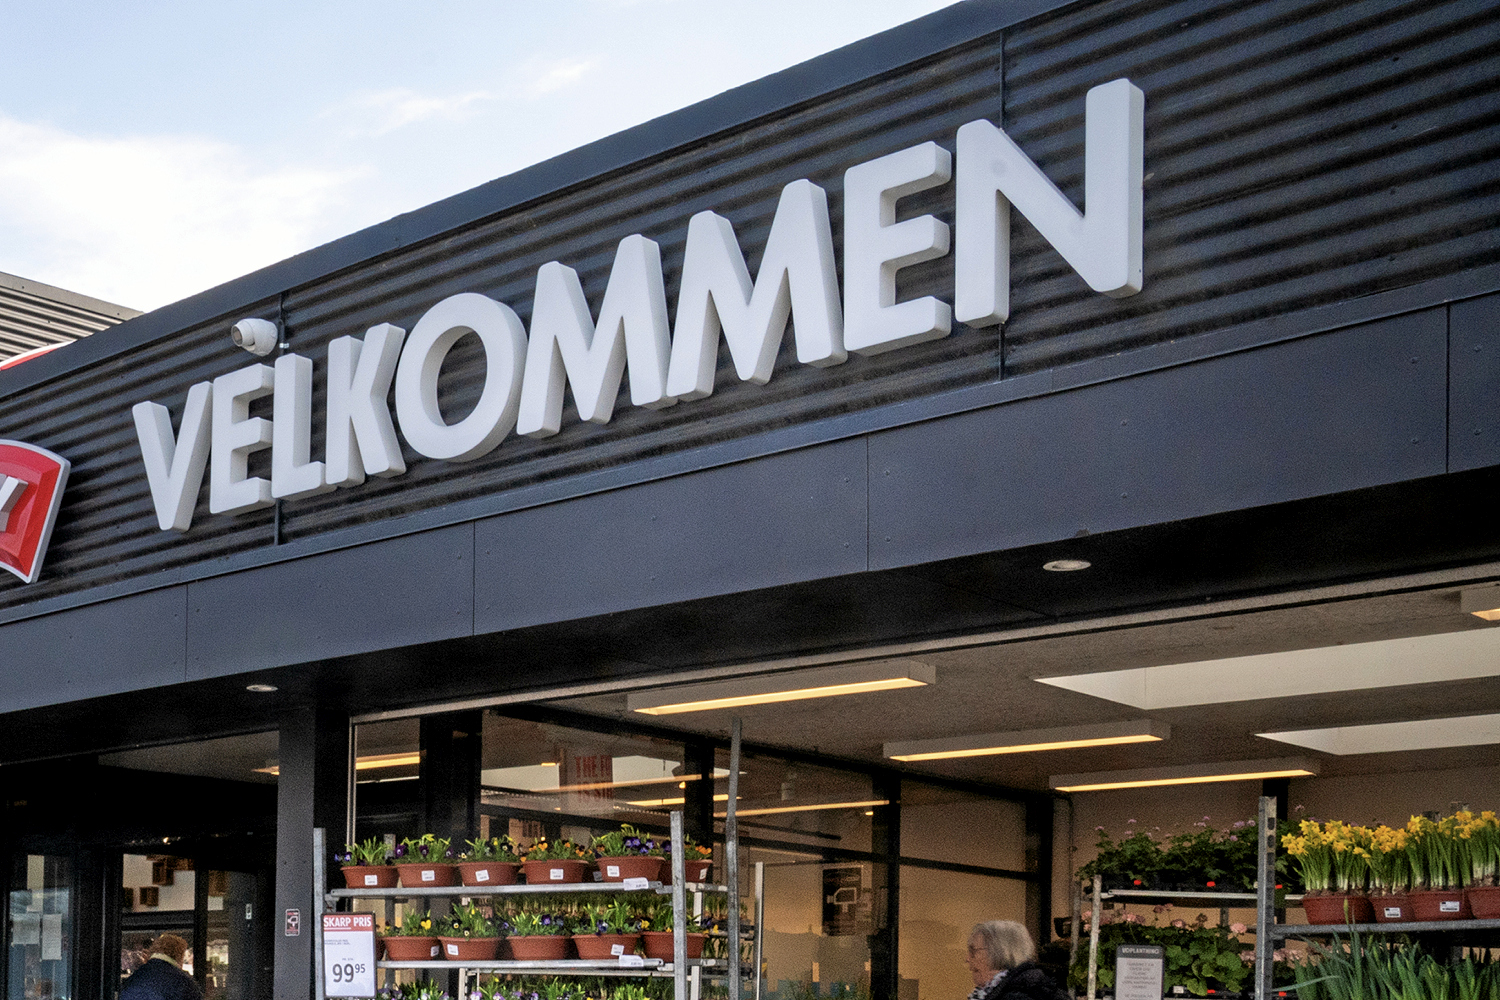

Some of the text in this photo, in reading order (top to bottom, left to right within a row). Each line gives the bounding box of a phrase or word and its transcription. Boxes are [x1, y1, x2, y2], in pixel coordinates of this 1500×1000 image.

[133, 78, 1144, 532] VELKOMMEN
[324, 917, 371, 927] SKARP PRIS
